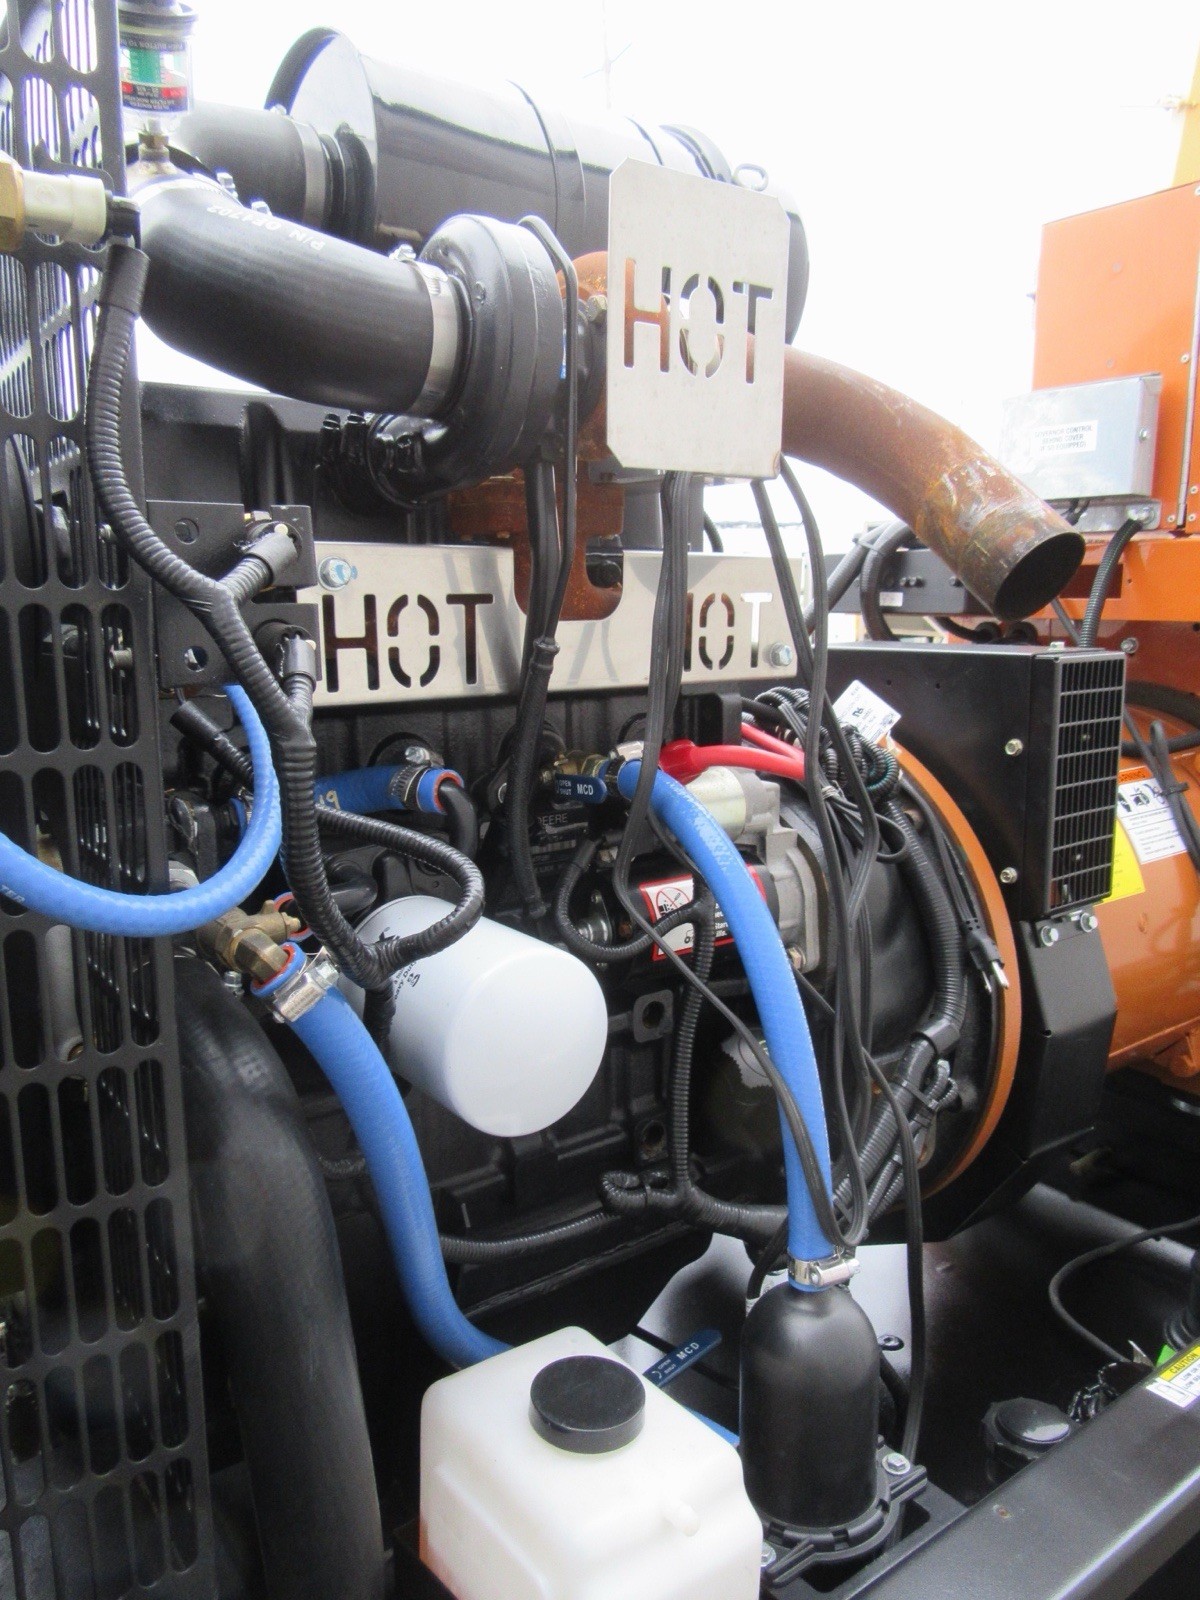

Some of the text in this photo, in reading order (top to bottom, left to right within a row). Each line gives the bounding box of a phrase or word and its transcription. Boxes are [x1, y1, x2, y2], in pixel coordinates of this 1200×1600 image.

[624, 257, 773, 384] HOT
[1065, 433, 1084, 441] COVER
[1066, 425, 1092, 434] CONTROL
[322, 593, 494, 693] HOT
[576, 783, 594, 795] MCD
[676, 1342, 700, 1360] MCD
[657, 1359, 671, 1370] OPEN
[1169, 1352, 1199, 1374] CAUTION
